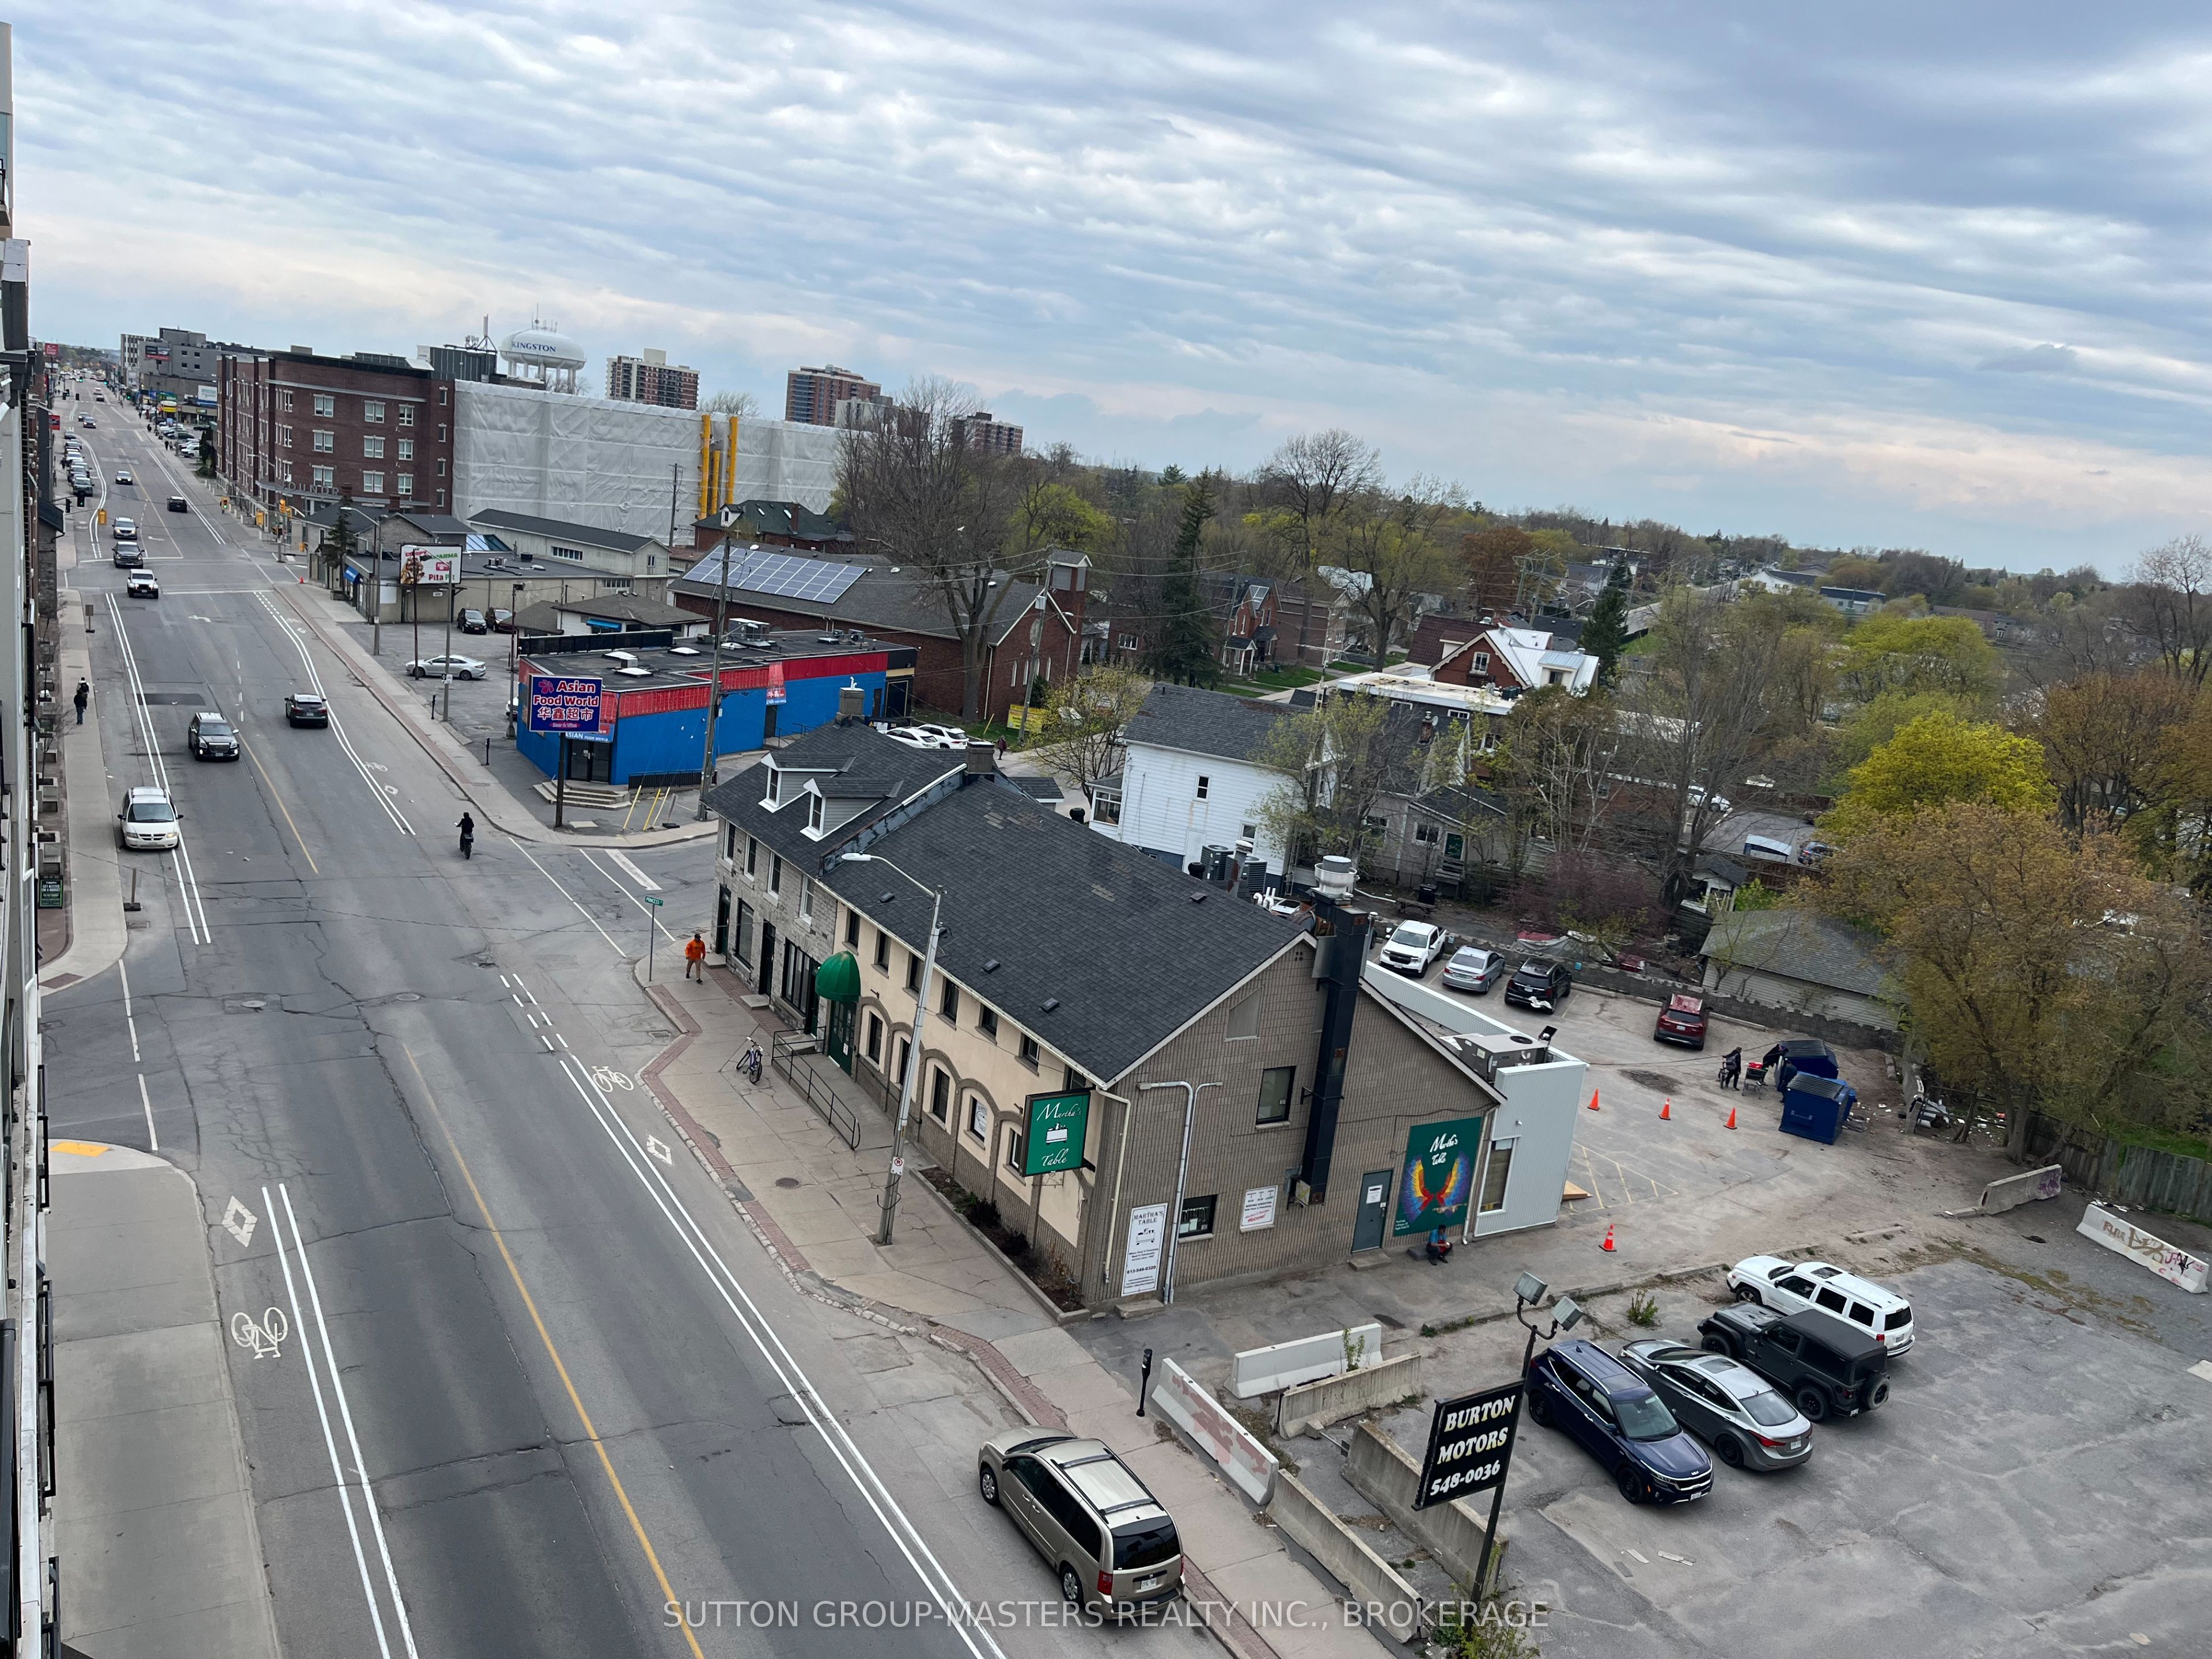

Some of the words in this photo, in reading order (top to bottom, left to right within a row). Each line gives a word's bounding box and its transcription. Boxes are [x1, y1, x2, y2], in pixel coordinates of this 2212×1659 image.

[512, 341, 556, 353] KINGSTON
[556, 680, 596, 694] Asian
[533, 695, 562, 706] Food
[564, 696, 599, 707] World
[537, 706, 594, 721] 华鑫超市
[1036, 1102, 1082, 1122] Martha's
[1041, 1148, 1069, 1166] Table
[1134, 1210, 1163, 1220] MARTHA'S
[1138, 1217, 1157, 1225] TABLE
[1444, 1395, 1516, 1433] BURTON
[1437, 1426, 1509, 1465] MOTORS
[1430, 1459, 1501, 1496] 548-0036
